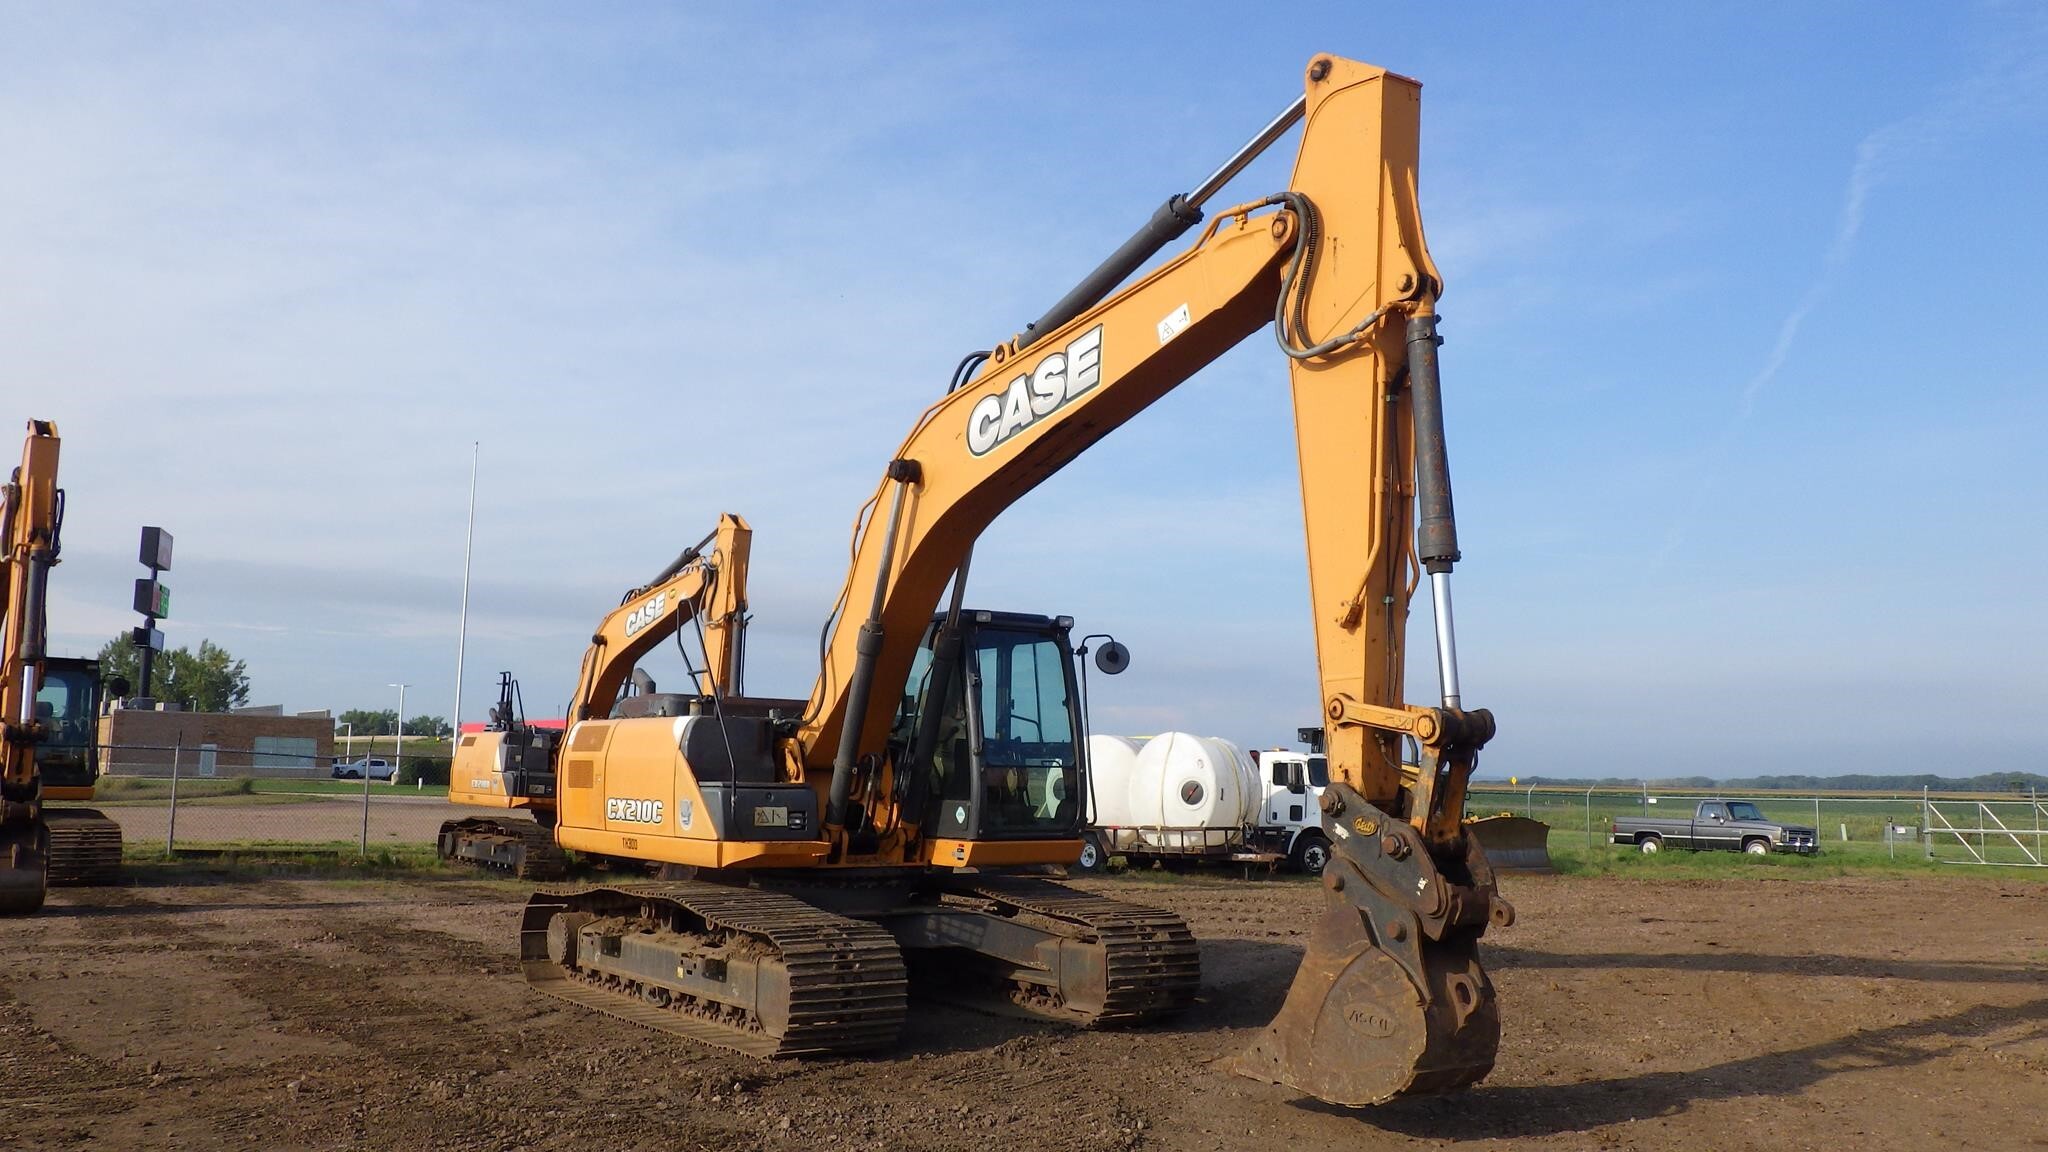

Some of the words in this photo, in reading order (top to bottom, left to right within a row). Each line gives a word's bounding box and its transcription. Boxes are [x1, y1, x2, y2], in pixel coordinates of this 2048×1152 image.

[967, 323, 1103, 457] CASE
[625, 591, 666, 637] CASE
[606, 797, 664, 825] CX210C
